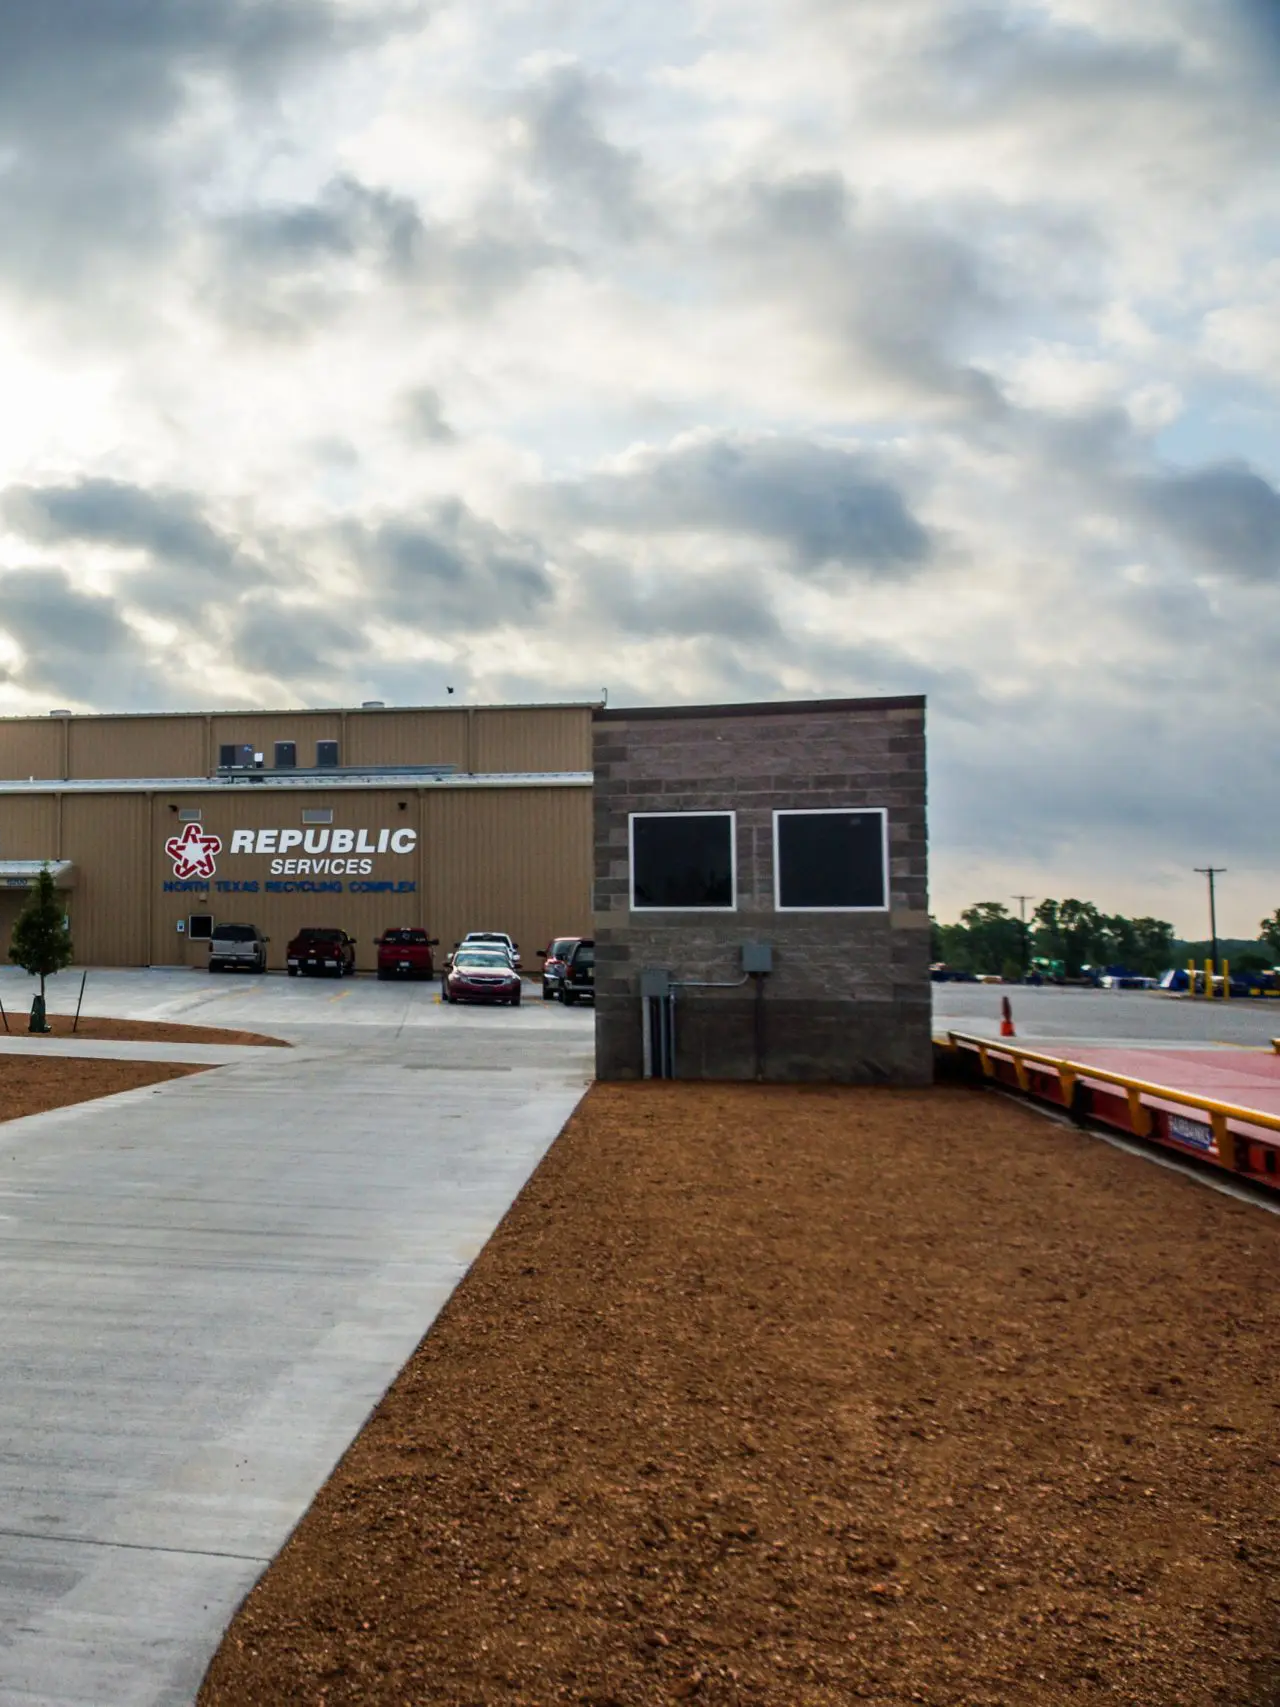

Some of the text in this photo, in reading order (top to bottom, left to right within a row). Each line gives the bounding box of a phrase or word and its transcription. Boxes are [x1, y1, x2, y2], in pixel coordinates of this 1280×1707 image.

[230, 828, 417, 854] REPUBLIC
[270, 858, 372, 875] SERVICES
[163, 880, 416, 893] NORTH TEXAS RECYCLING COMPLEX
